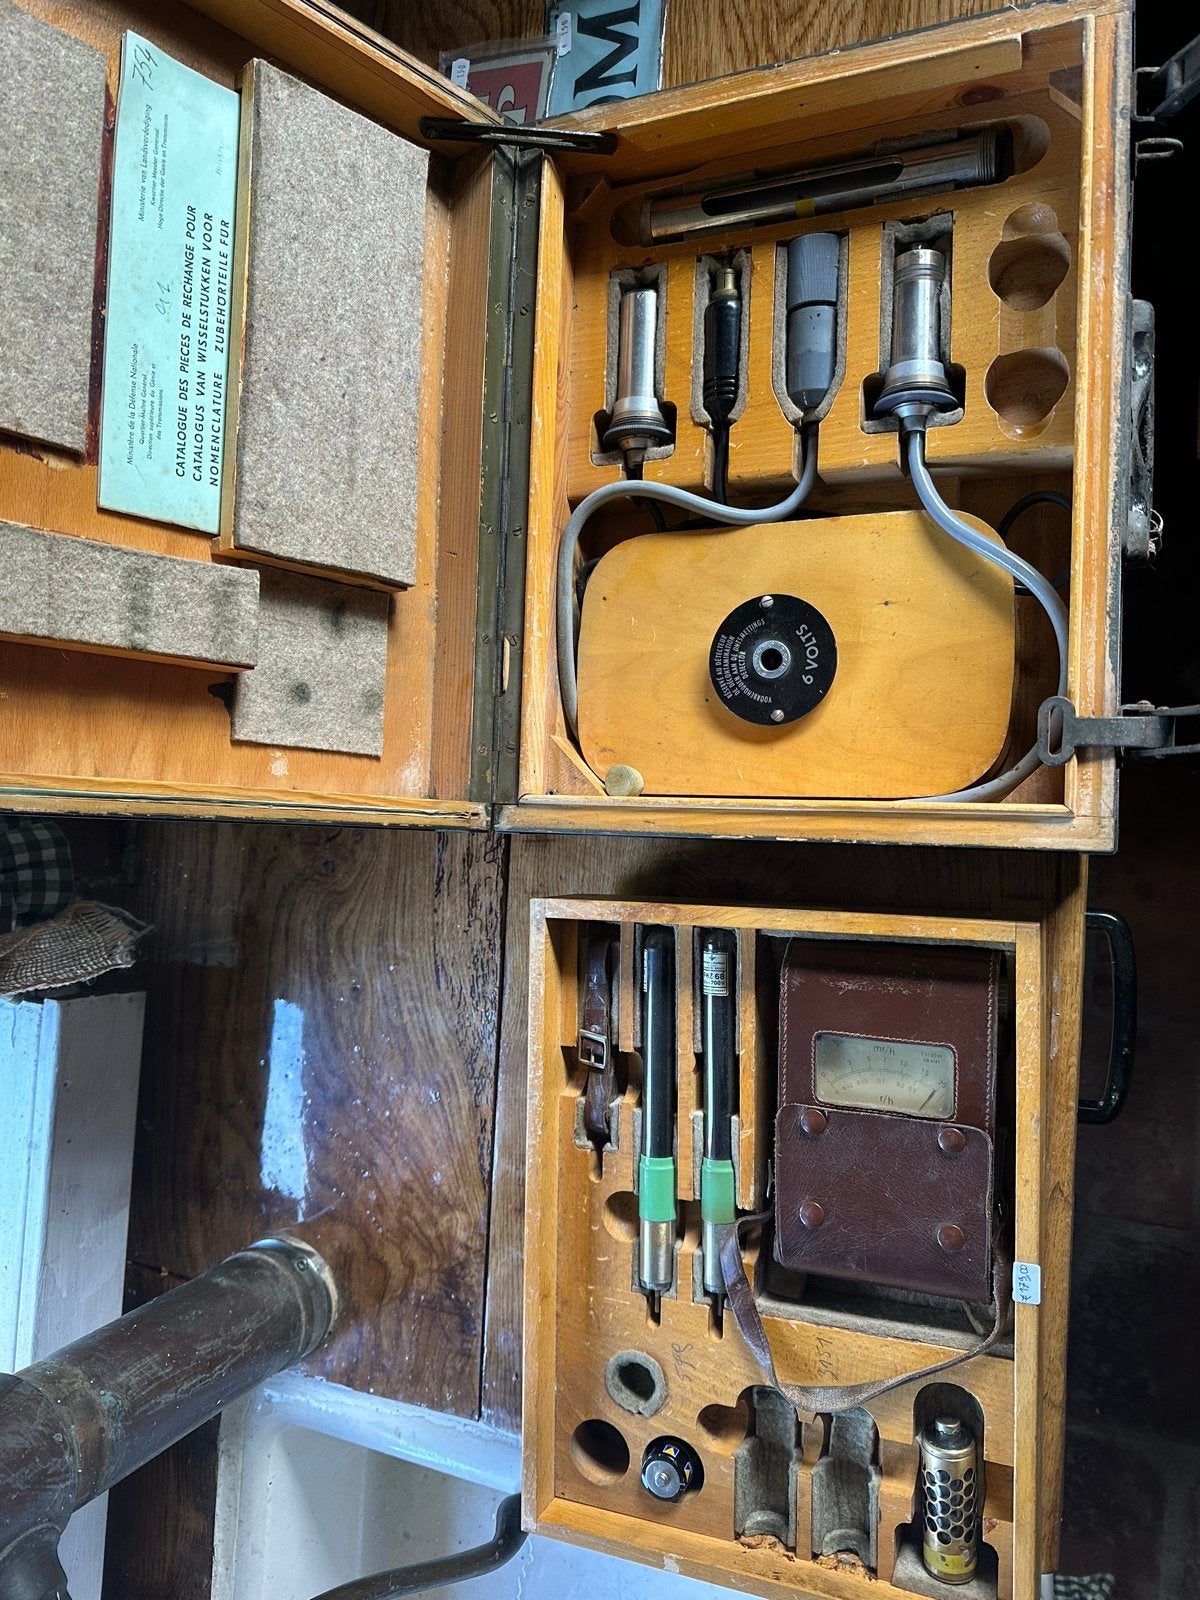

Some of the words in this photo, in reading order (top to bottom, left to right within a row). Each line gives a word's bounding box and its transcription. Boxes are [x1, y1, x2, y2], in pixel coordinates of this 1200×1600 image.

[132, 44, 158, 91] 754
[573, 0, 641, 108] M
[140, 103, 152, 168] Landsverdediging
[140, 170, 148, 183] van
[137, 185, 147, 222] Ministerie
[185, 205, 197, 239] POUR
[202, 212, 213, 251] VOOR
[182, 244, 195, 308] RECHANGE
[181, 312, 192, 328] DE
[196, 257, 211, 363] WISSELSTUKKEN
[130, 343, 139, 379] Nationale
[179, 334, 191, 374] PIECES
[128, 380, 137, 409] Défense
[149, 389, 156, 398] du
[179, 379, 189, 401] DES
[196, 371, 206, 396] VAN
[127, 420, 135, 430] de
[128, 411, 135, 419] la
[148, 400, 156, 431] supérieure
[209, 372, 223, 487] NOMENCLATURE
[126, 431, 135, 465] Ministère
[175, 405, 187, 478] CATALOGUE
[192, 405, 205, 482] CATALOGUS
[713, 634, 728, 666] DÉTECTEUR
[730, 653, 738, 663] DE
[795, 623, 819, 670] VOLTS
[715, 667, 722, 677] AU
[730, 664, 739, 676] AAN
[738, 650, 749, 680] DETECTOR
[732, 687, 741, 697] DE
[873, 1044, 896, 1056] mr/h
[900, 1059, 909, 1068] 10
[879, 1094, 894, 1106] r/h
